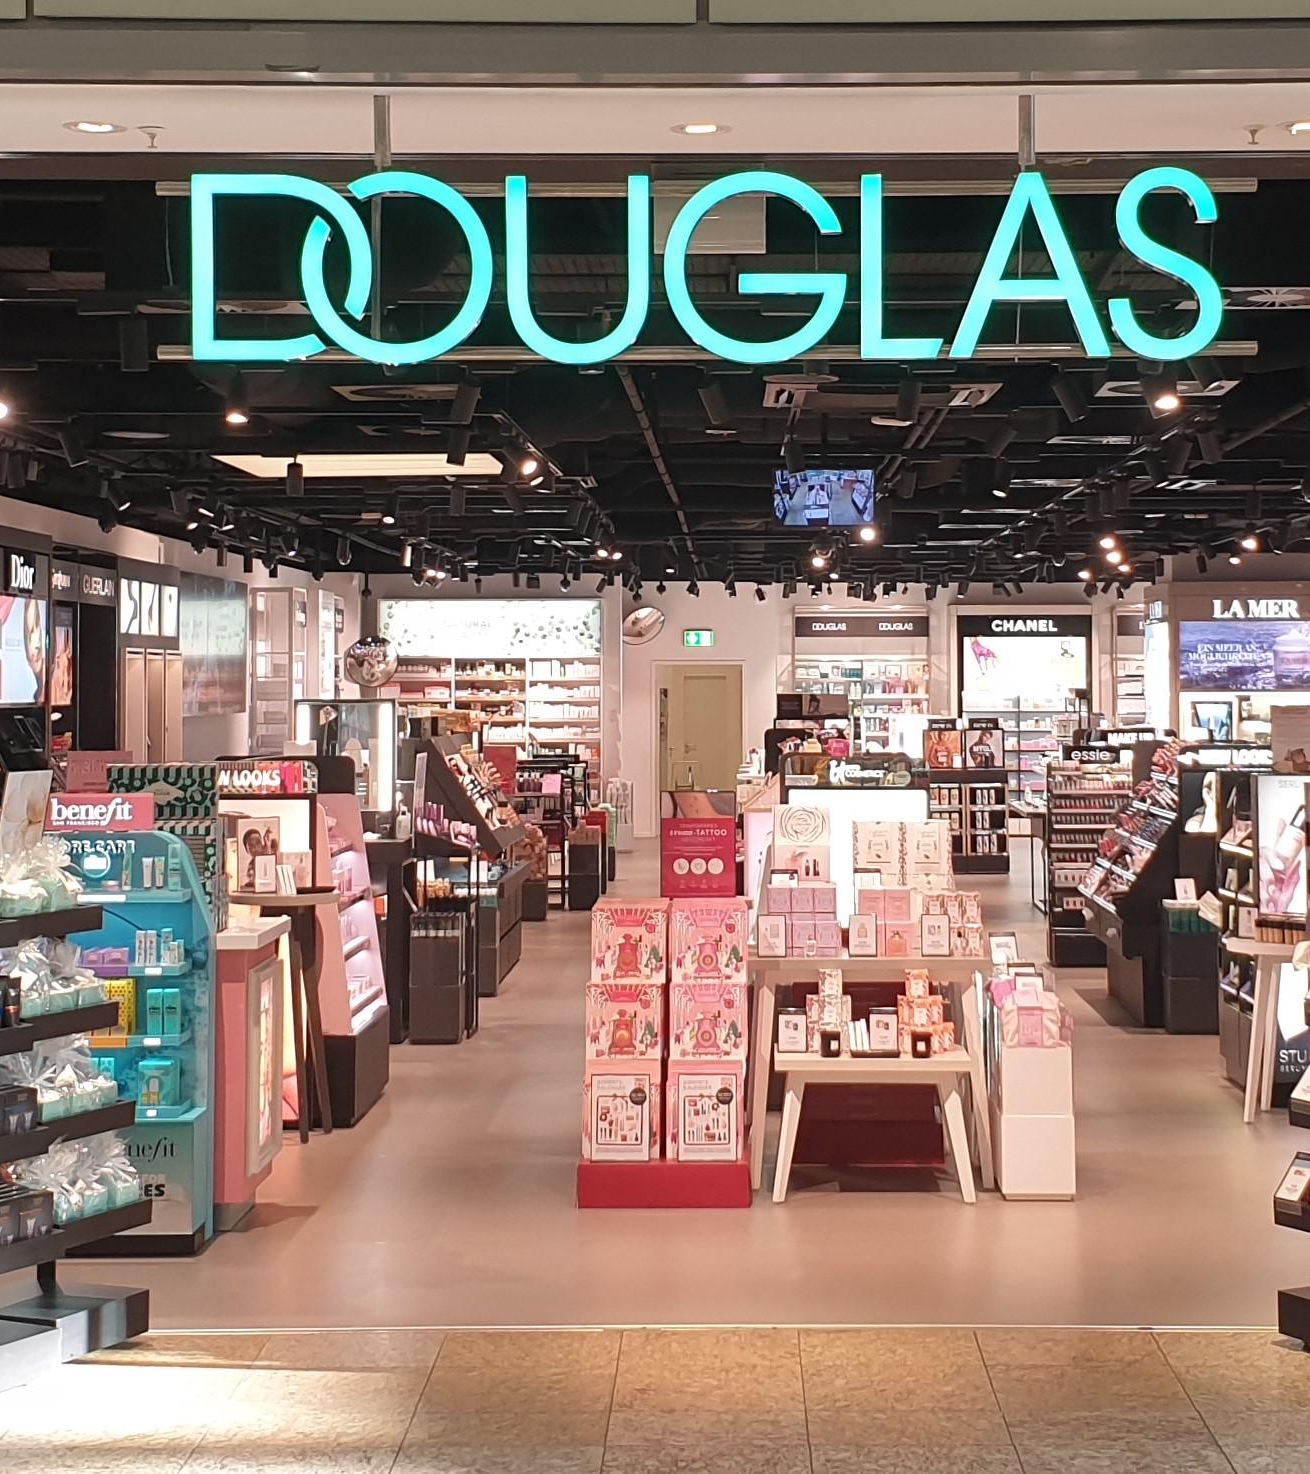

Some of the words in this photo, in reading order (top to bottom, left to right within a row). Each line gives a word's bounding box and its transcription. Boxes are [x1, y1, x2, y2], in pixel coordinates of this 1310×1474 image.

[191, 166, 1226, 364] DOUGLAS
[11, 554, 35, 590] Dior
[83, 574, 115, 597] GUERLAIN
[1212, 599, 1245, 618] LA
[1247, 599, 1300, 618] MER
[812, 622, 847, 631] DOUGLAS
[878, 622, 913, 631] DOUGLAS
[991, 619, 1058, 632] CHANEL
[1071, 748, 1110, 762] essie
[232, 769, 281, 787] LOOKS
[51, 797, 133, 827] benefit
[1279, 1049, 1308, 1063] STU
[127, 1136, 177, 1162] nefit
